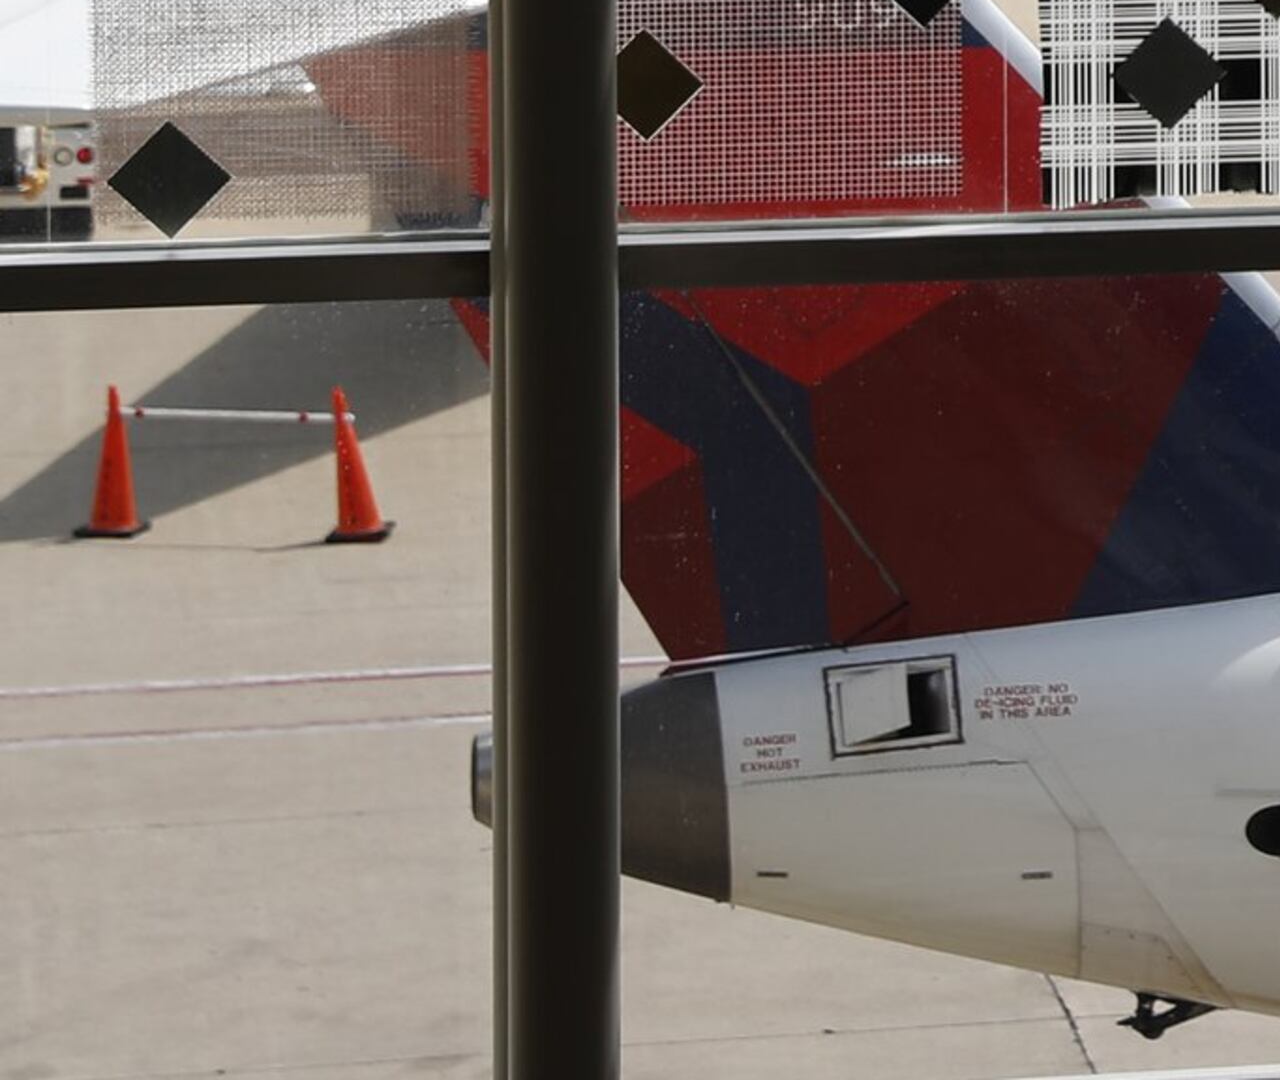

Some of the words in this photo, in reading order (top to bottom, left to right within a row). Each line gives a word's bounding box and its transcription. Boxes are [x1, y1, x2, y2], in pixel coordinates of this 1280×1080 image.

[1048, 683, 1069, 694] NO
[1041, 694, 1079, 706] FLUID
[1000, 708, 1030, 719] THIS
[1035, 706, 1072, 717] AREA
[740, 758, 800, 773] EXHAUST
